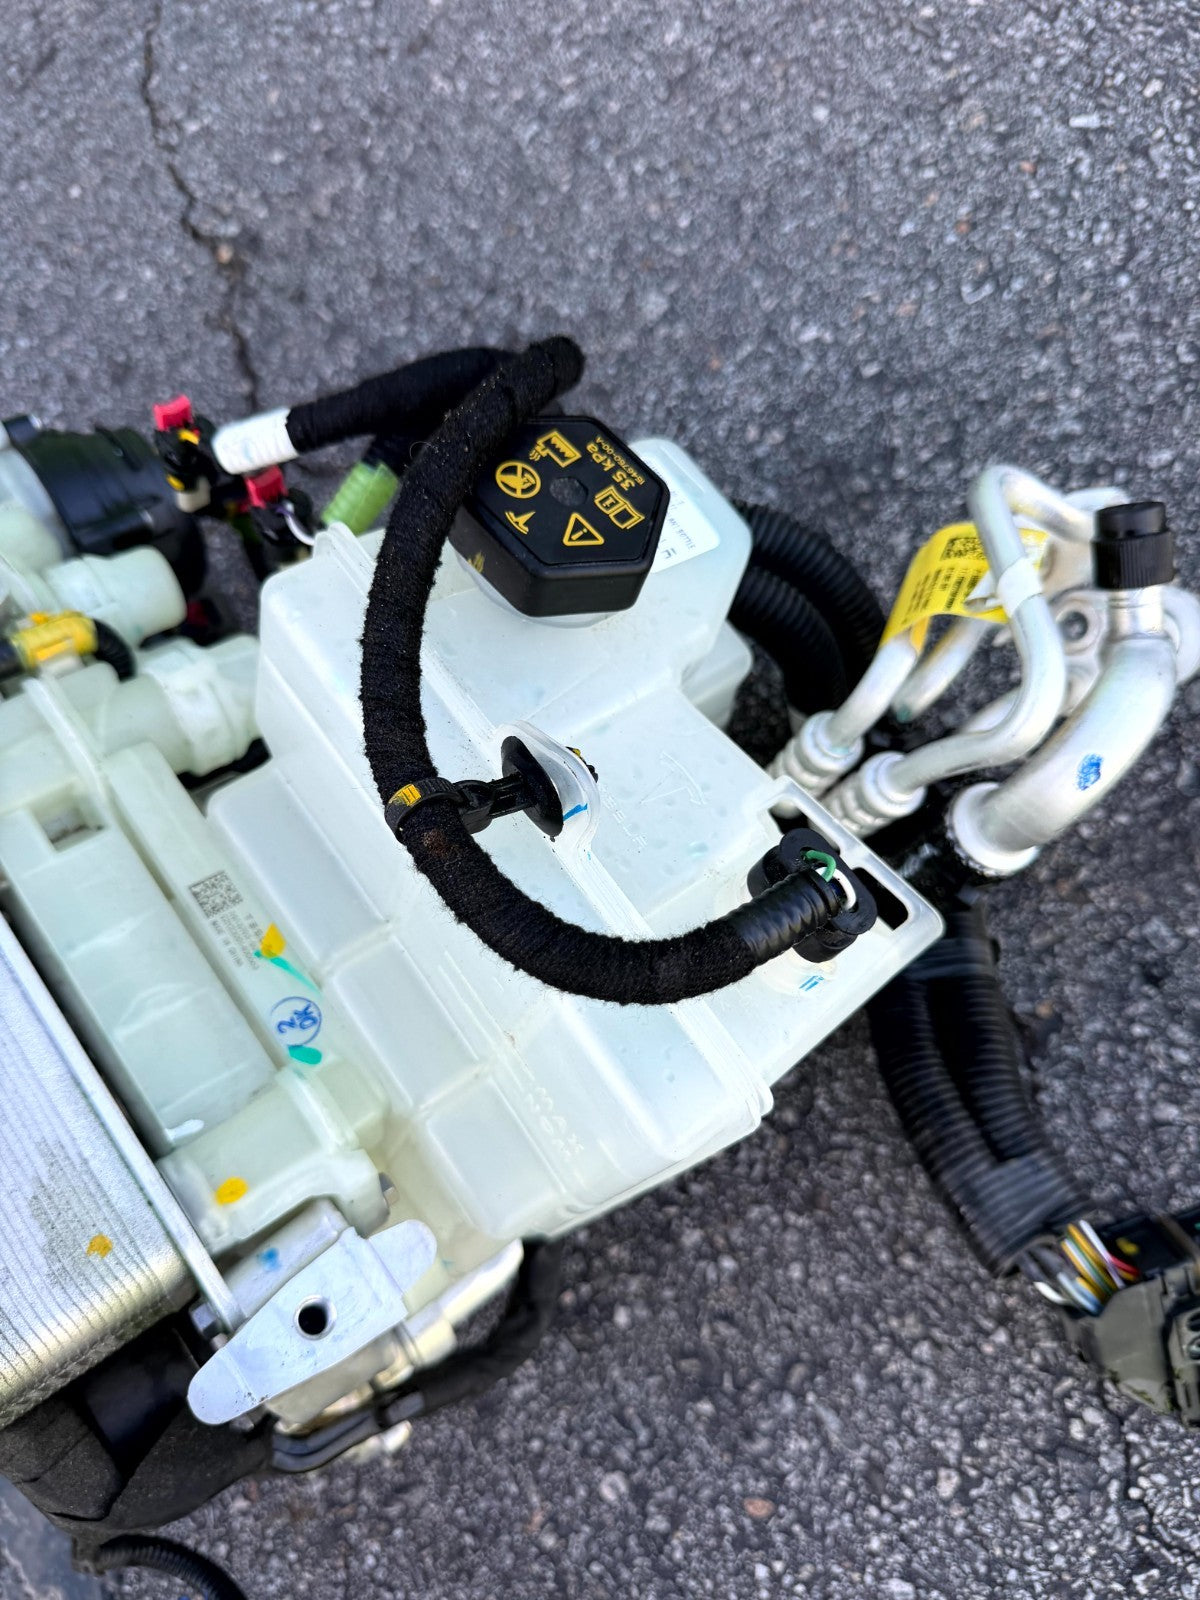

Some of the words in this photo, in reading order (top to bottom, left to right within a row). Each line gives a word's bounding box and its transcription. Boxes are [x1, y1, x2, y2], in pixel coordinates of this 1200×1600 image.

[586, 443, 615, 471] kPa
[612, 471, 635, 490] 35
[277, 1016, 295, 1033] 2
[293, 1001, 318, 1030] OK
